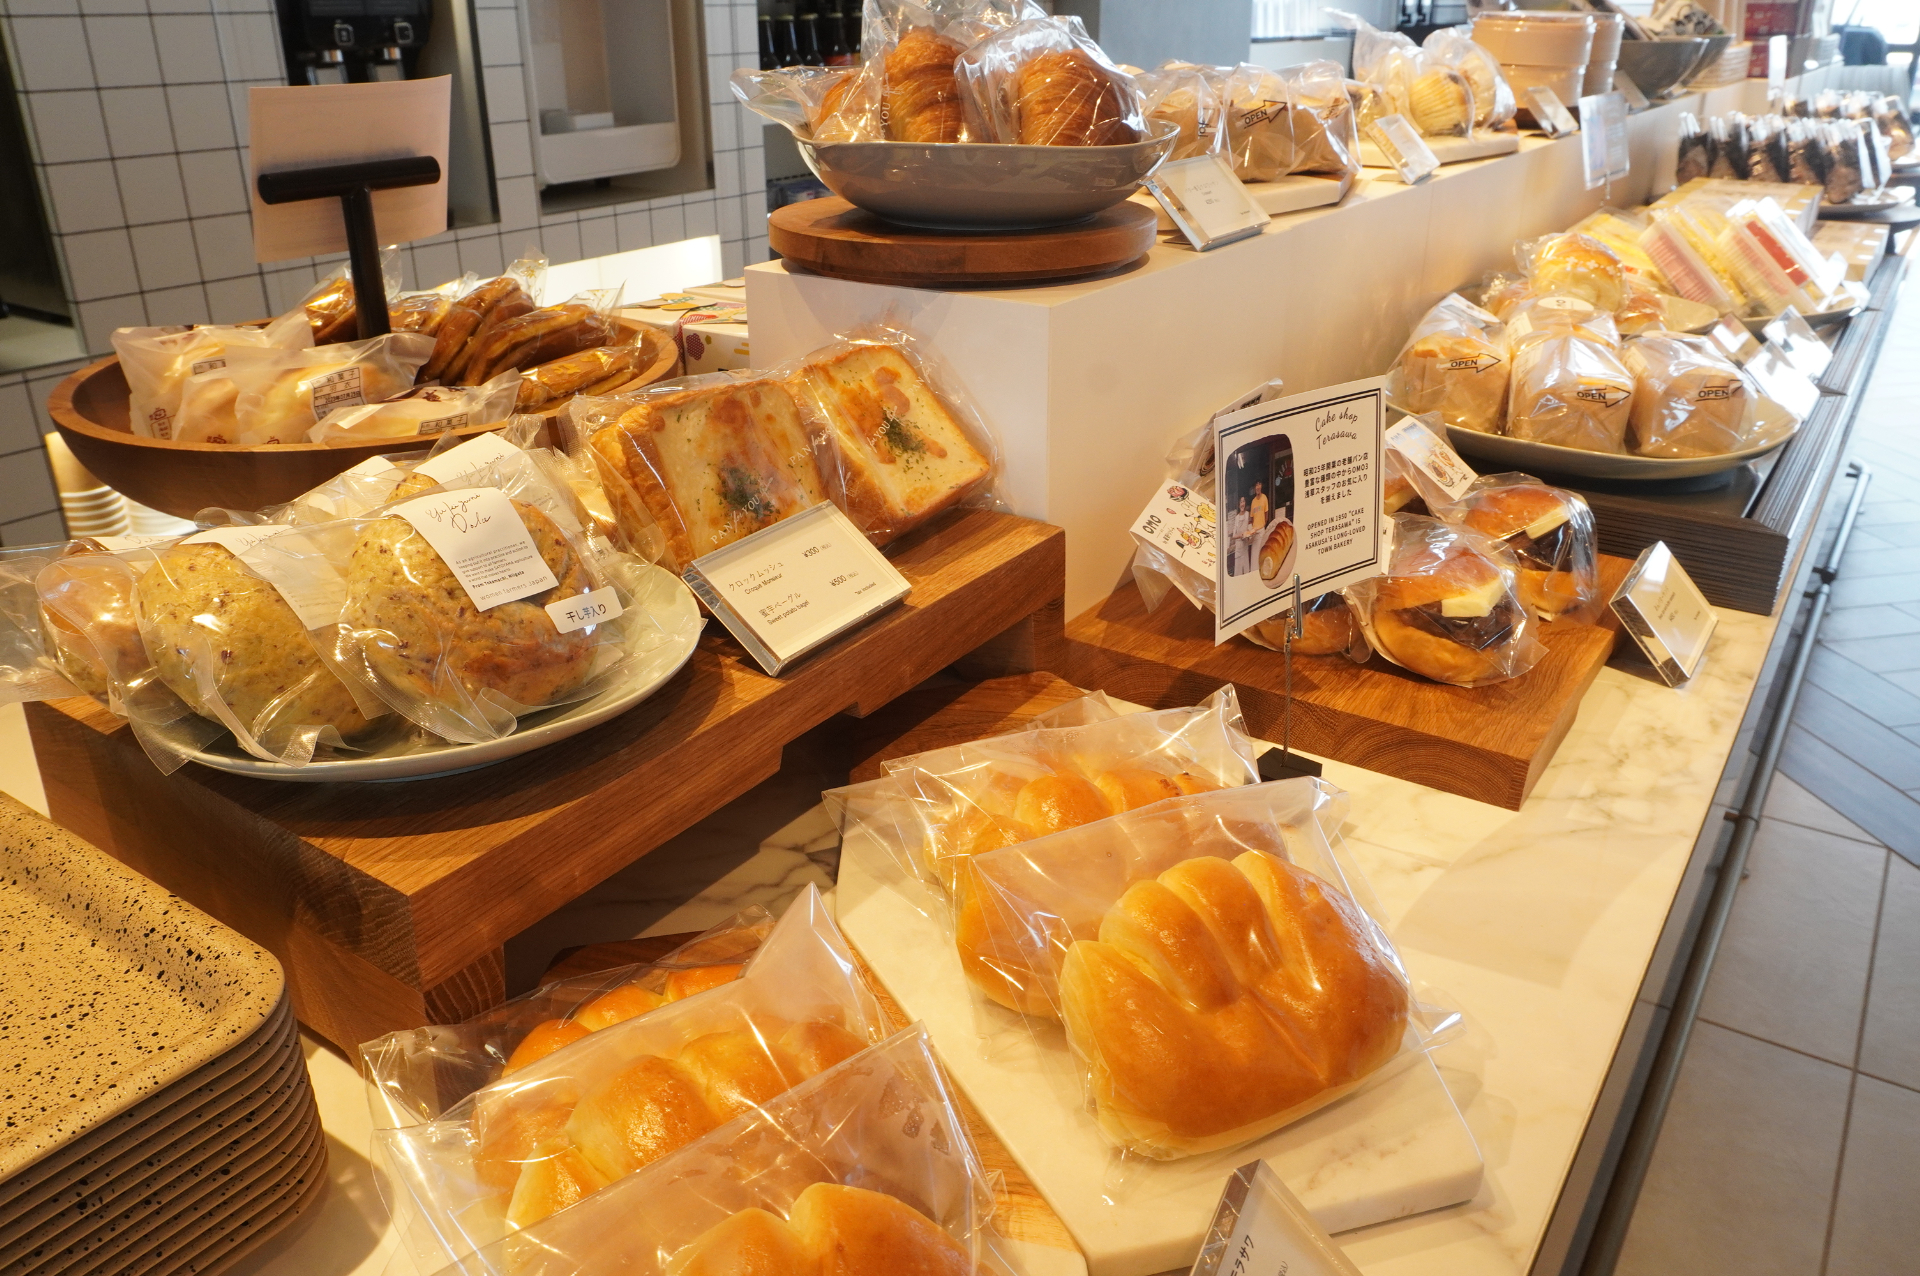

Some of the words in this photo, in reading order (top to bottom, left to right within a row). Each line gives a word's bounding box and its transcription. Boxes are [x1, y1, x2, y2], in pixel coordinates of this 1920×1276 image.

[1244, 108, 1268, 126] OPEN
[1450, 358, 1478, 370] OPEN
[1576, 391, 1606, 401] OPEN
[1698, 388, 1729, 399] OPEN
[1315, 410, 1336, 432] Cake
[1339, 407, 1358, 425] shop
[873, 420, 892, 440] YOU
[1316, 430, 1358, 450] Terasawa
[788, 445, 813, 465] PAN
[1304, 474, 1368, 499] 浅草スタッフのお気に入り
[1320, 489, 1352, 504] を揃えました
[710, 526, 733, 546] PAN
[739, 496, 761, 517] YOU
[1142, 514, 1162, 535] OMO
[1307, 519, 1328, 531] OPENED
[1328, 516, 1335, 524] IN
[1310, 529, 1325, 540] SHOP
[1333, 525, 1366, 541] LONG-LOVED
[801, 546, 820, 558] ¥300
[1318, 544, 1333, 556] TOWN
[1333, 537, 1354, 550] BAKERY
[729, 562, 784, 592] クロックムッシュ
[829, 574, 847, 587] ¥500
[744, 583, 763, 595] Croque
[565, 603, 607, 623] 干し芋入り
[782, 607, 798, 619] potato
